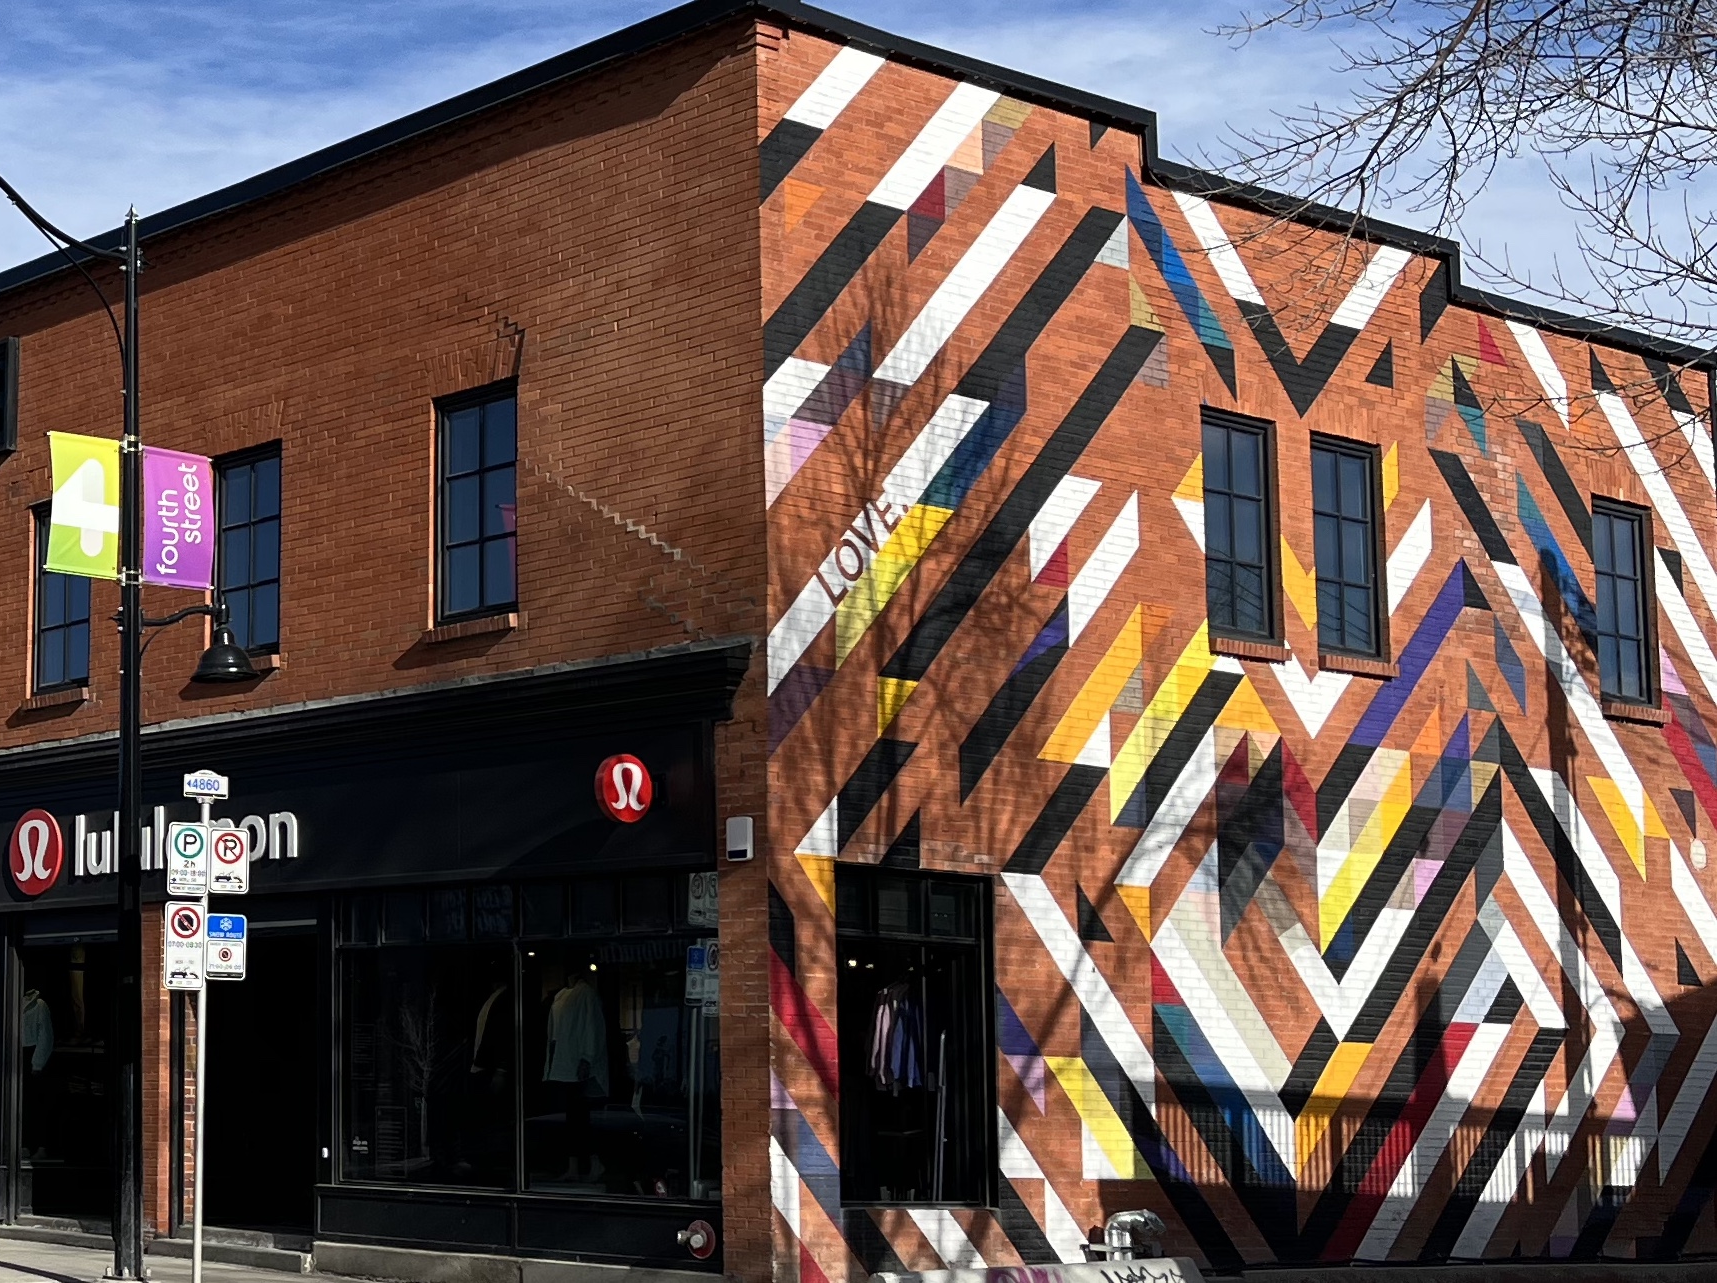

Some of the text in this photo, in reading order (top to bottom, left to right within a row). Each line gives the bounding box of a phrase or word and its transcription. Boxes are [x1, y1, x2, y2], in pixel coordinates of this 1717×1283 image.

[52, 458, 120, 558] 4
[155, 489, 180, 575] fourth
[177, 462, 202, 544] street
[192, 778, 220, 791] 4860
[183, 833, 198, 853] P
